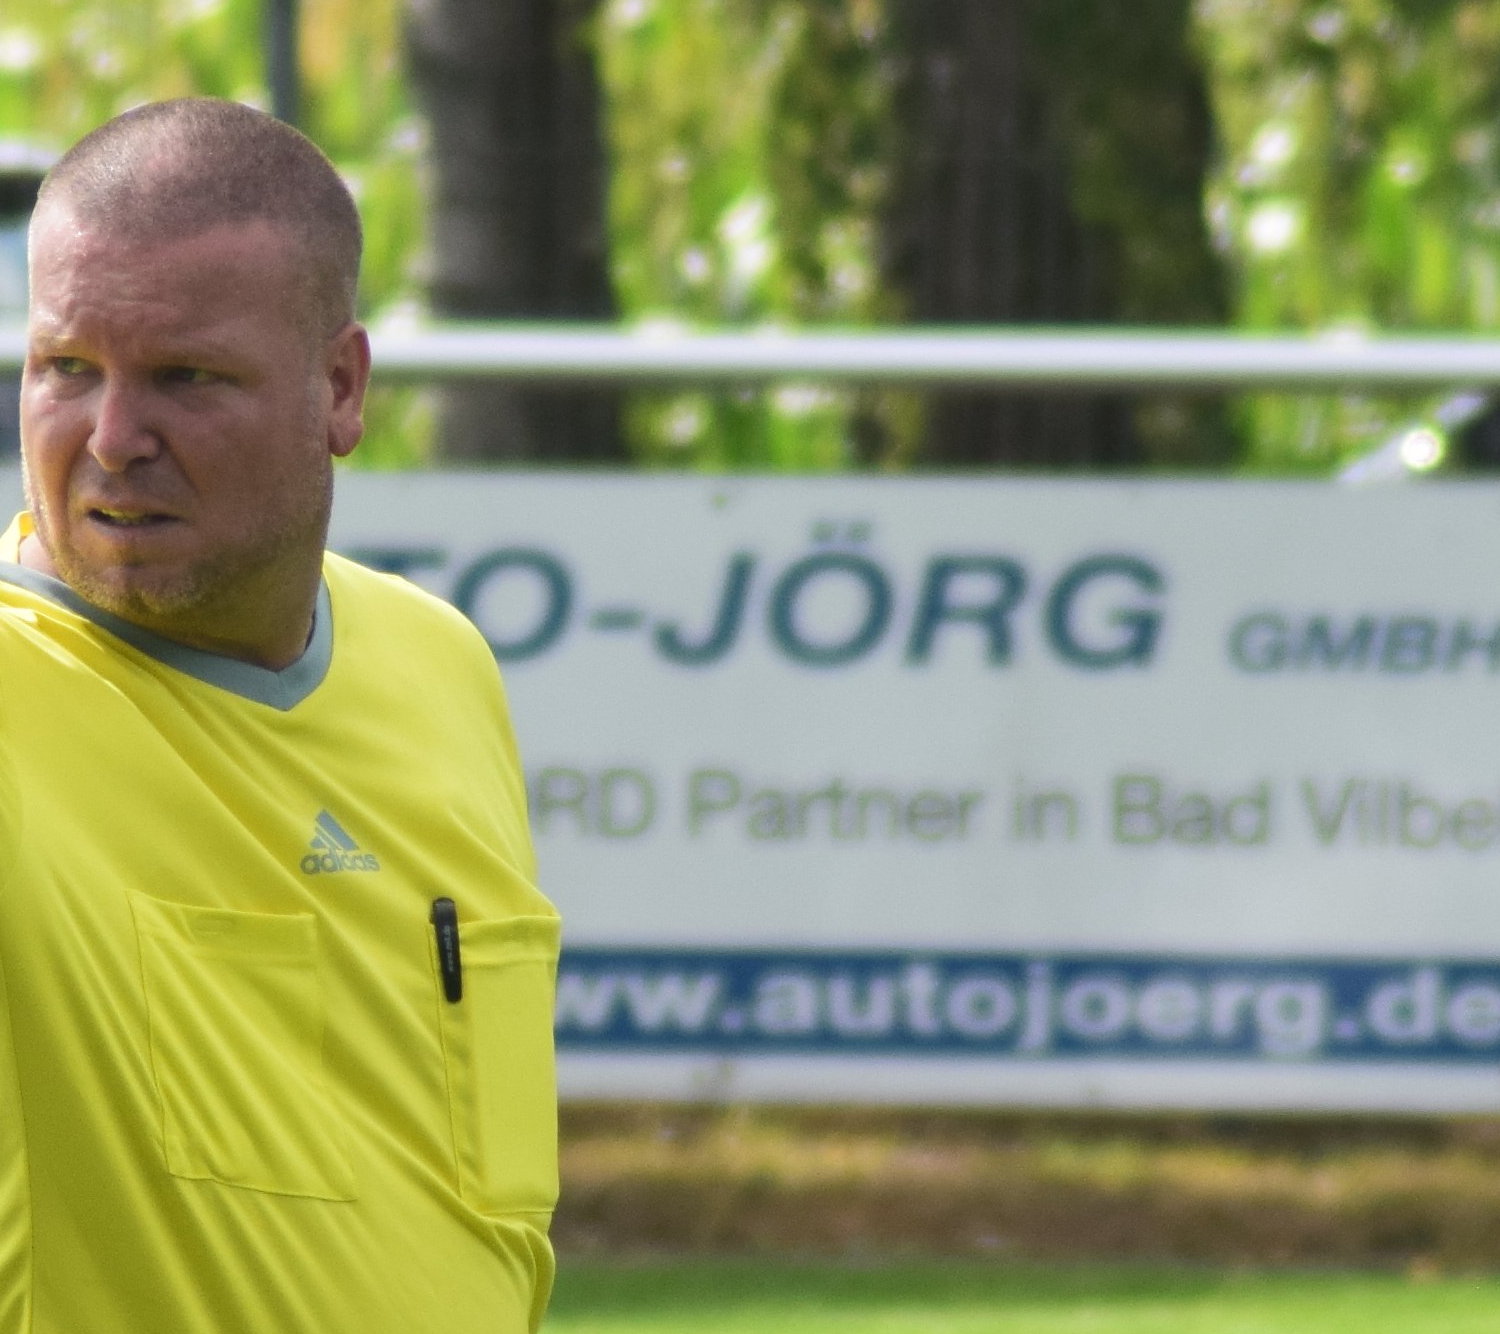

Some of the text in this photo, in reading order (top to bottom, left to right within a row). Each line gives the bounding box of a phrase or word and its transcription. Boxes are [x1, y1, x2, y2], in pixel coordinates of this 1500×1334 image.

[687, 766, 985, 842] Partner
[1013, 777, 1078, 842] in
[1111, 774, 1271, 847] Bad
